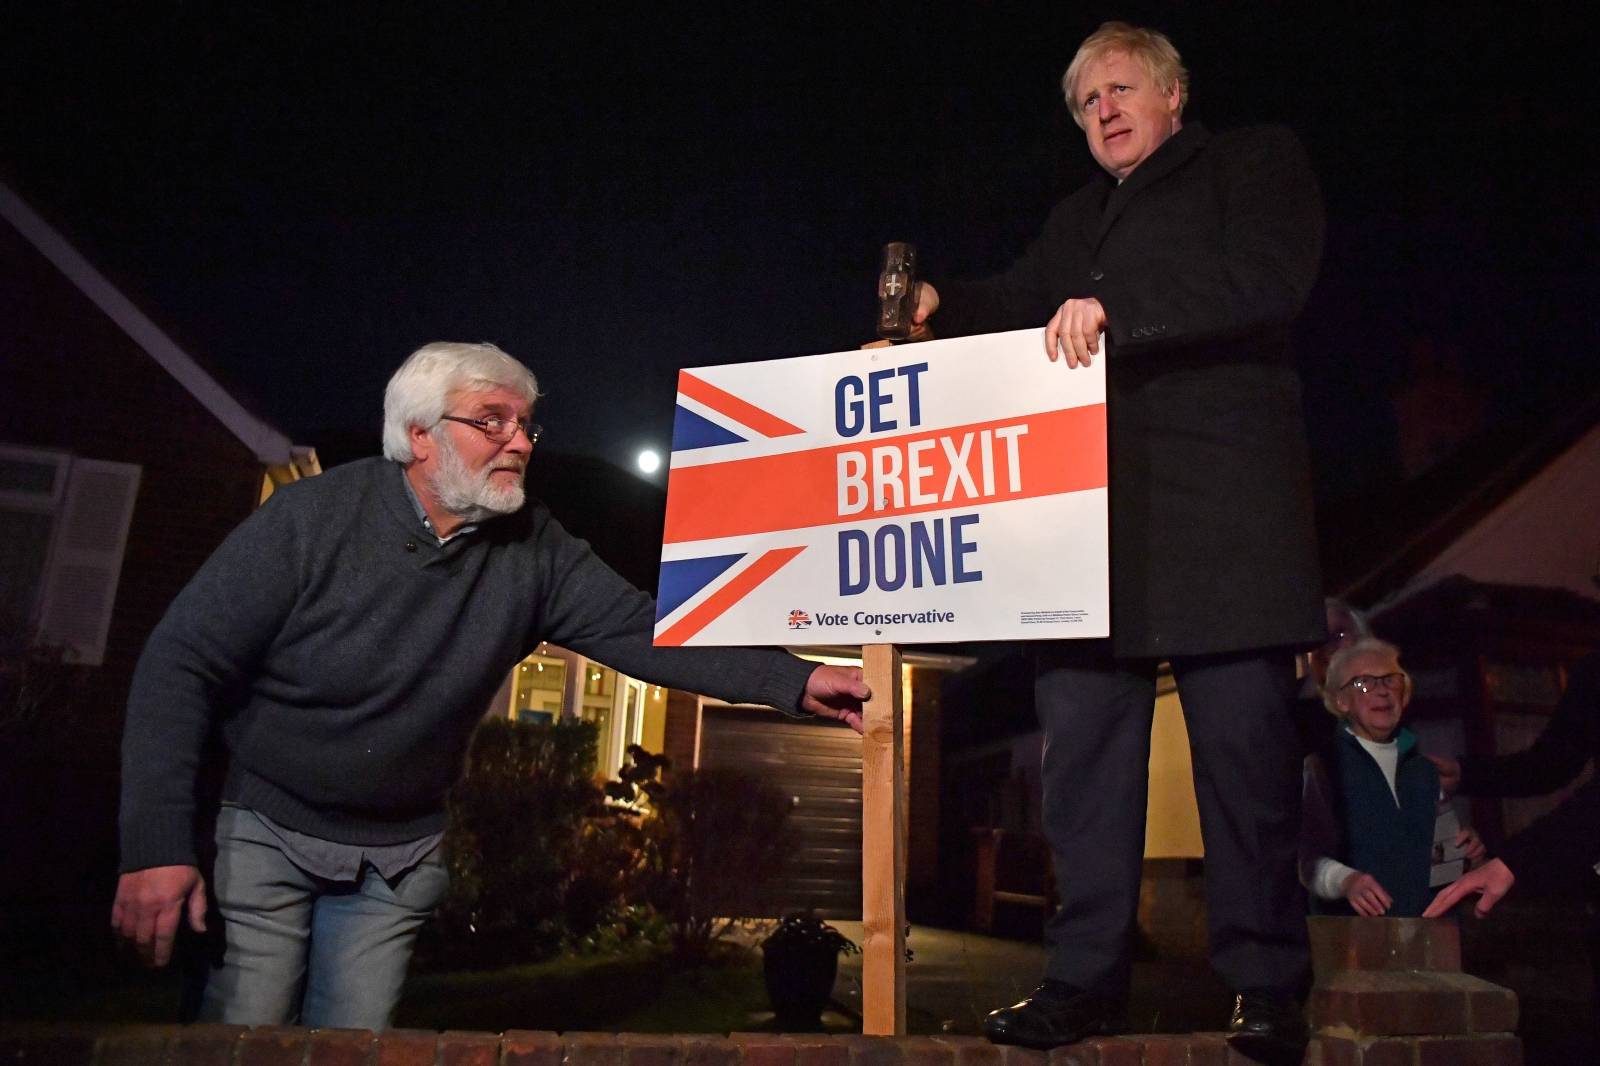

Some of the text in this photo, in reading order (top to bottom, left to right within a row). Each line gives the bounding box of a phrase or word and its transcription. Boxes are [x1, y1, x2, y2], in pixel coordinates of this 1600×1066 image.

[834, 362, 928, 437] GET
[836, 424, 1028, 516] BREXIT
[838, 514, 982, 596] DONE
[815, 609, 954, 626] Vote Conservative
